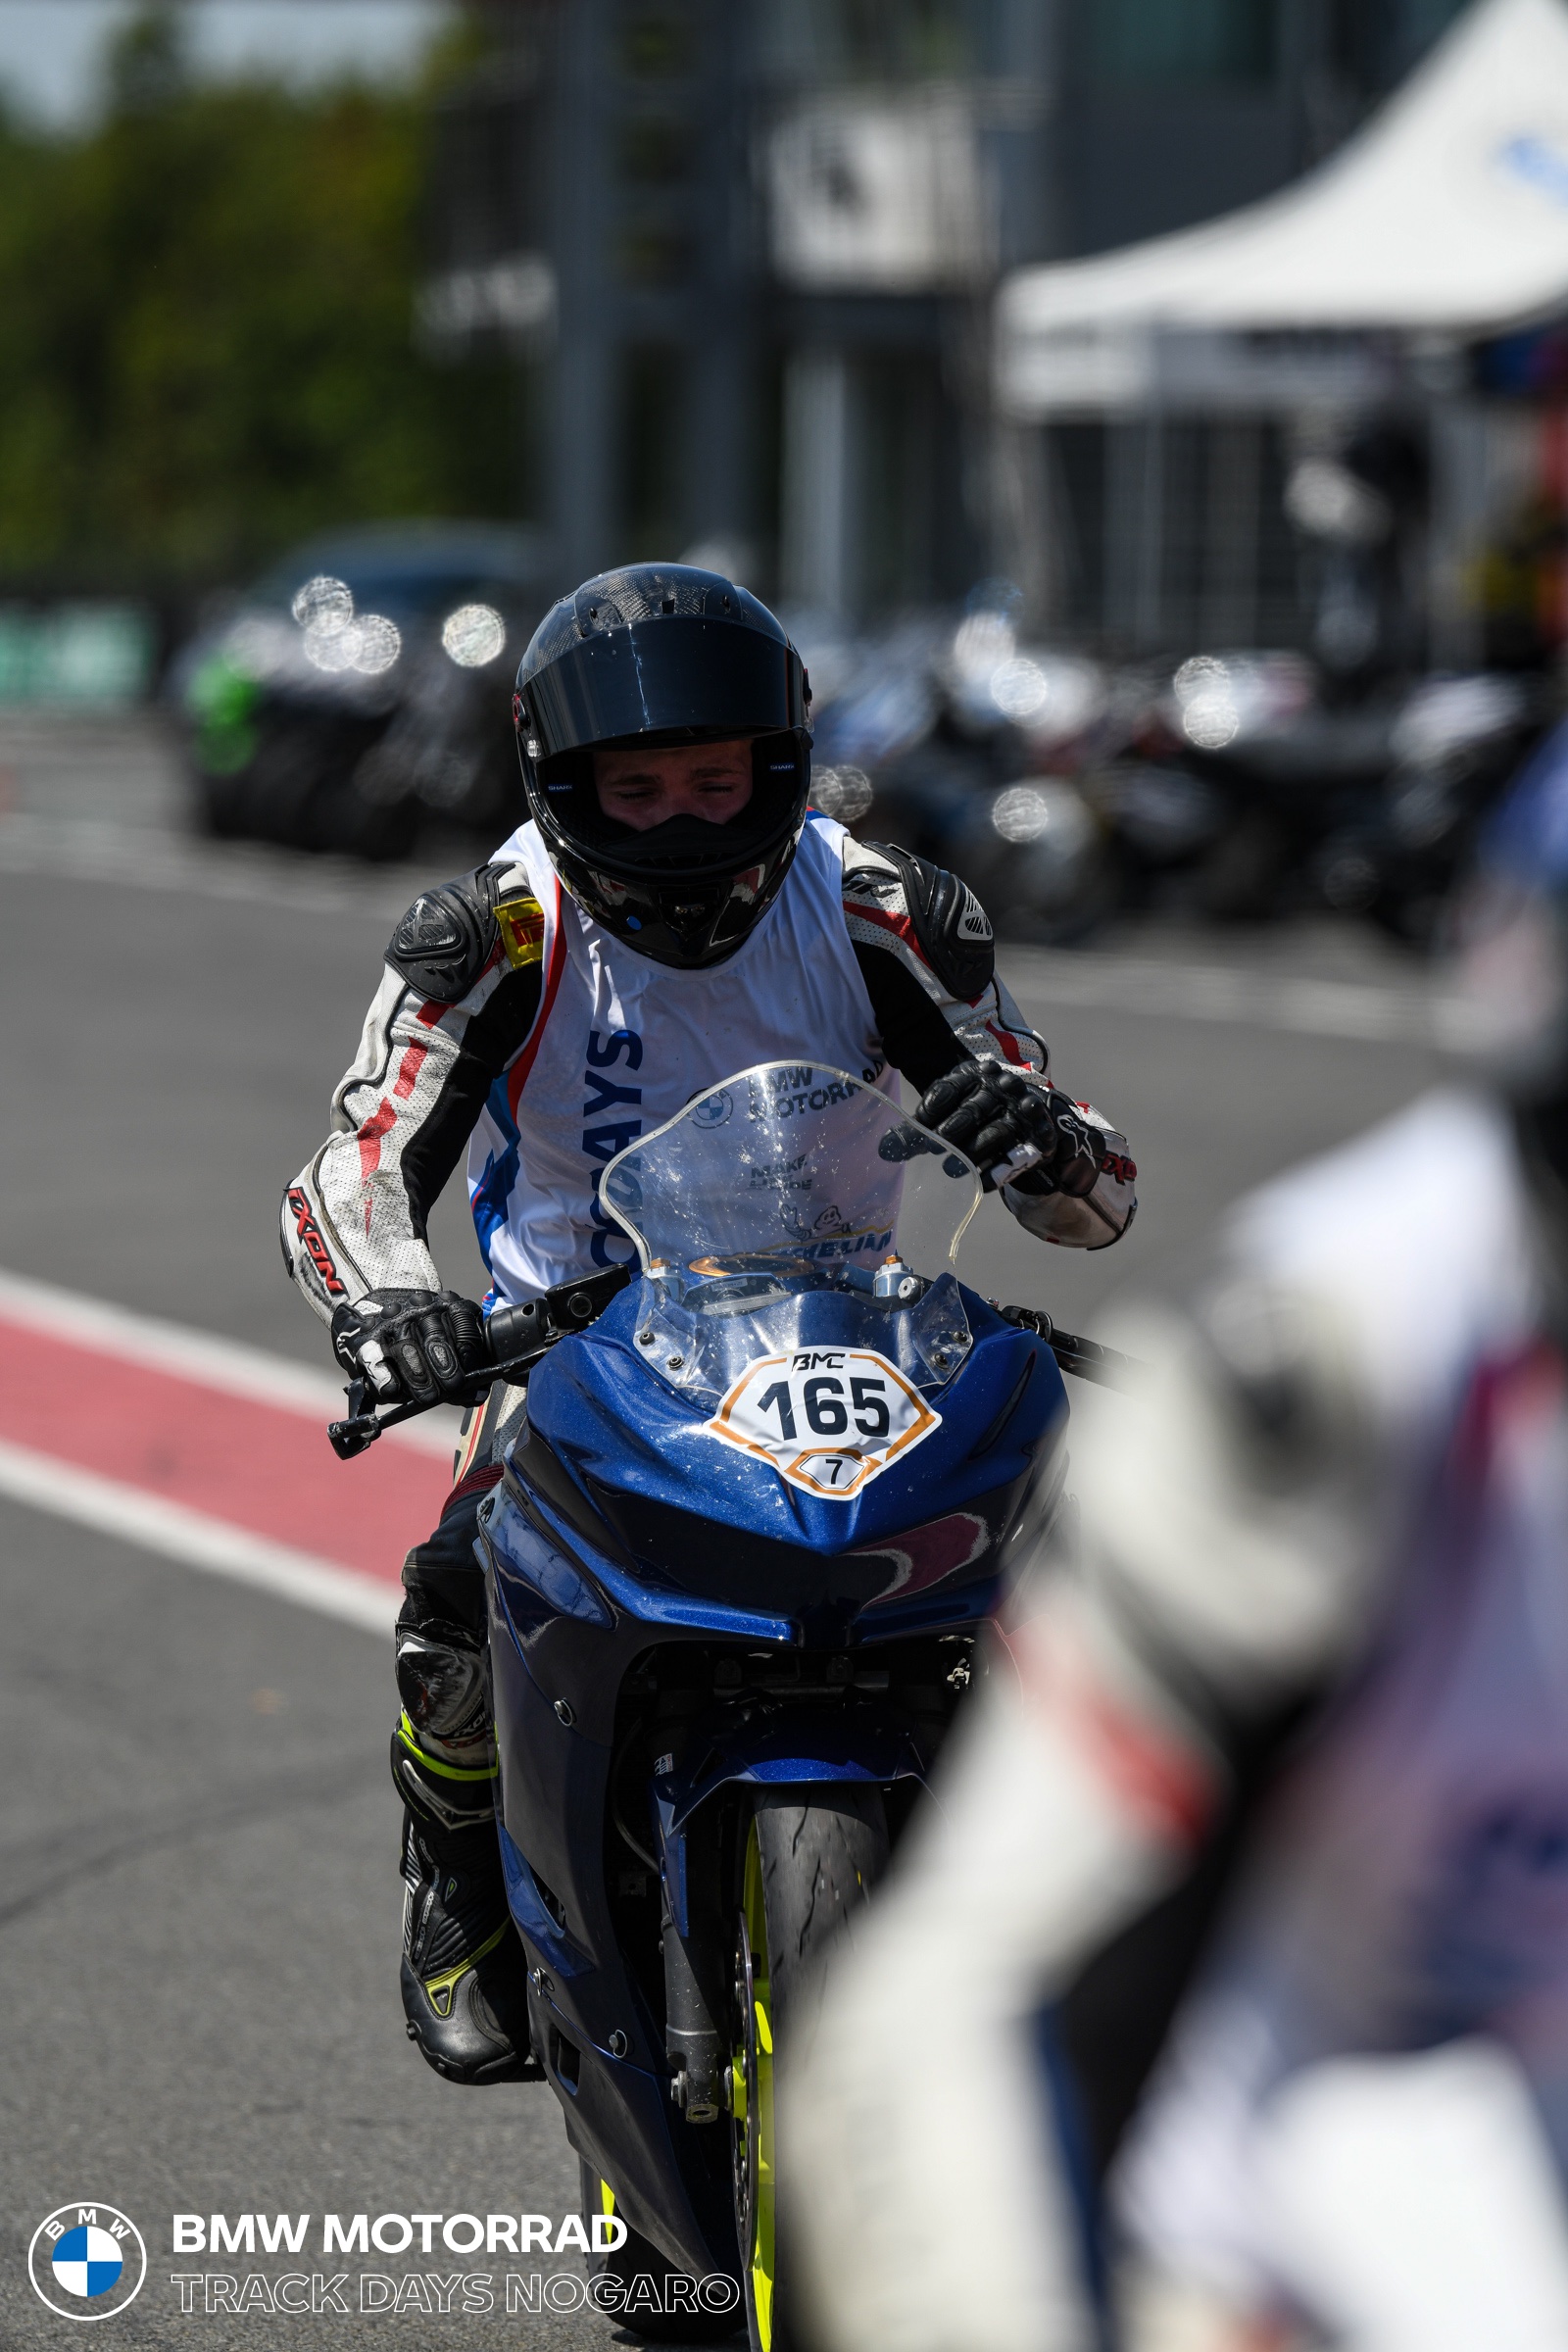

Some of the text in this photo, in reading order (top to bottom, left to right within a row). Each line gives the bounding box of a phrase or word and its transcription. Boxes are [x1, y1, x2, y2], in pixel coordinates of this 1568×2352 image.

[792, 1352, 846, 1372] BMC
[757, 1376, 890, 1442] 165
[825, 1458, 844, 1486] 7
